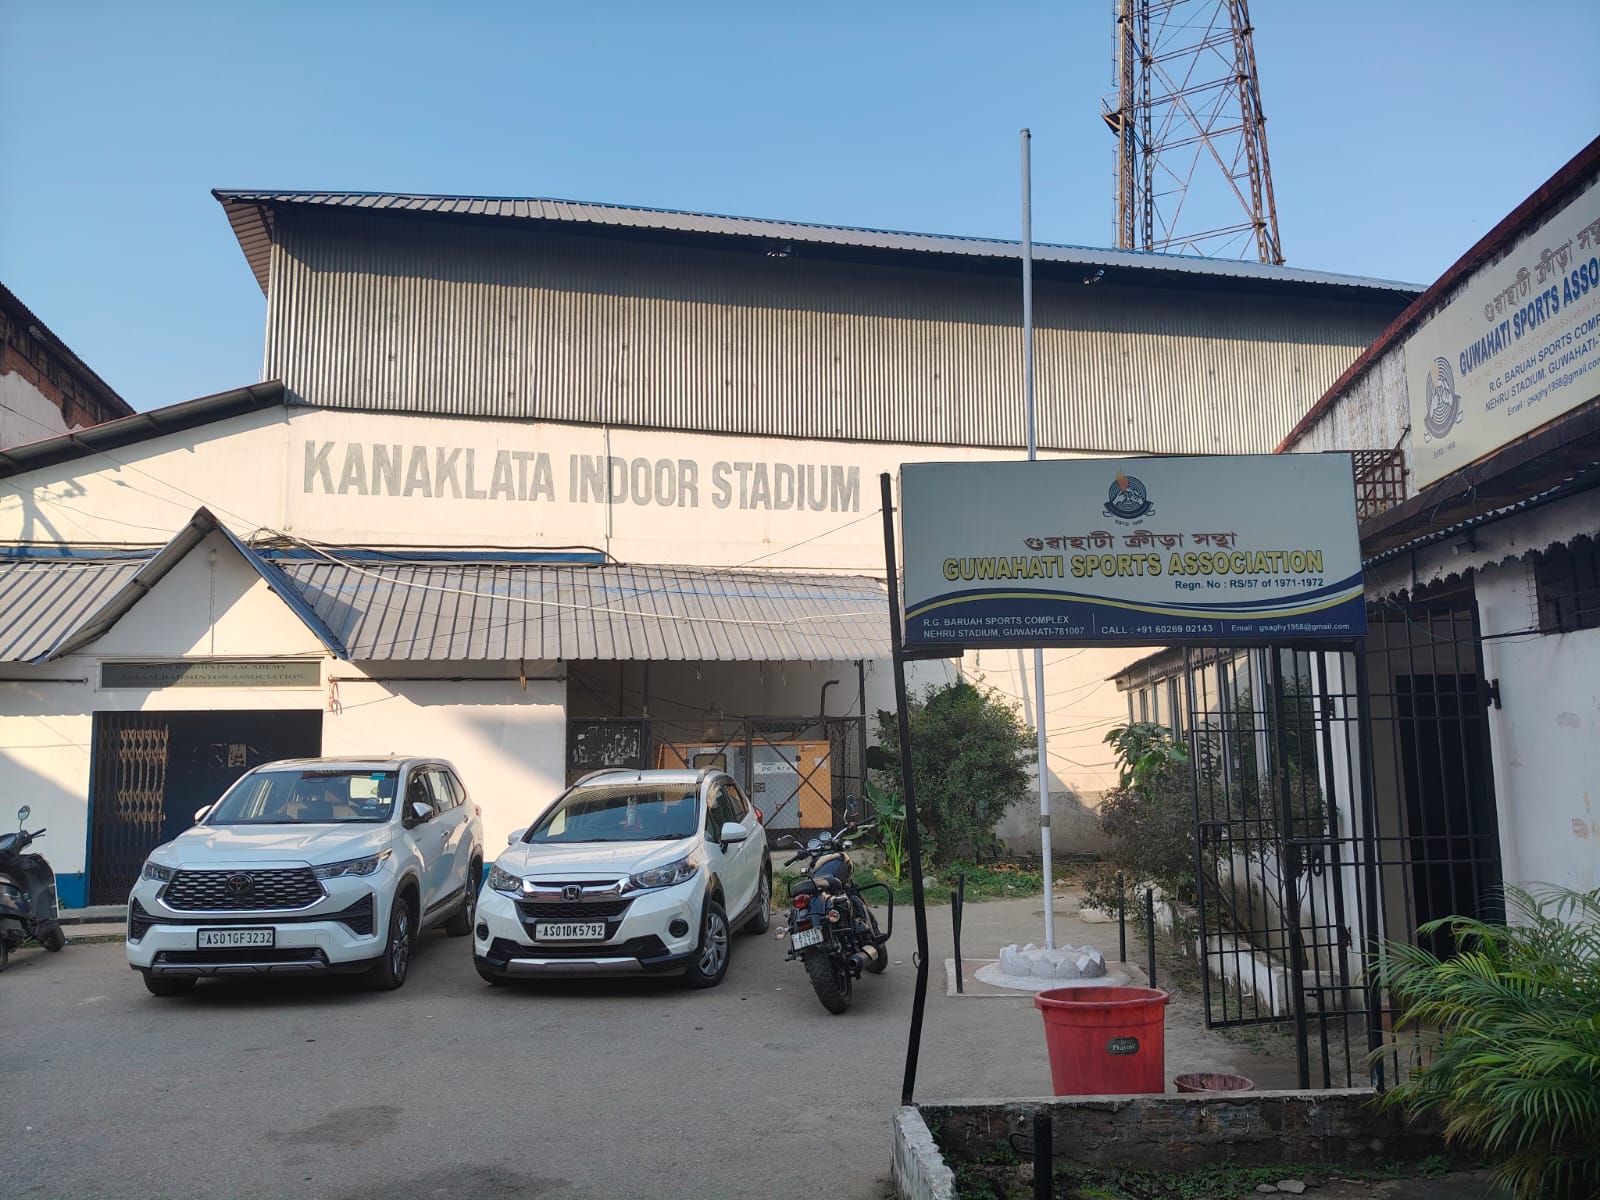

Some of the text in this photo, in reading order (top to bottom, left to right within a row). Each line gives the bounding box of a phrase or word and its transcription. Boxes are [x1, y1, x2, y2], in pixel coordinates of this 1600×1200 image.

[1459, 256, 1600, 378] GUWAHATI SPORTS ASSO
[1504, 355, 1537, 384] BARUAH
[1538, 332, 1572, 362] SPORTS
[1485, 389, 1510, 413] NEHRU
[304, 440, 861, 512] KANAKLATA INDOOR STADIUM
[943, 550, 1324, 581] GUWAHATI SPORTS ASSOCIATION
[1175, 580, 1203, 592] Regn.
[1207, 580, 1221, 589] No
[1230, 579, 1258, 589] RS/57
[1261, 578, 1271, 588] of
[1274, 578, 1323, 588] 1971-1972
[923, 616, 1069, 627] R.G. BARUAH SPORTS COMPLEX
[1231, 624, 1253, 632] Email
[923, 627, 1084, 638] NEHRU STADIUM, GUWAHATI-781007
[1101, 626, 1128, 634] CALL
[1136, 625, 1152, 634] +91
[1155, 625, 1183, 633] 60269
[1185, 624, 1213, 633] 02143
[542, 925, 603, 937] AS01DK5792
[206, 932, 272, 945] AS01GF3232
